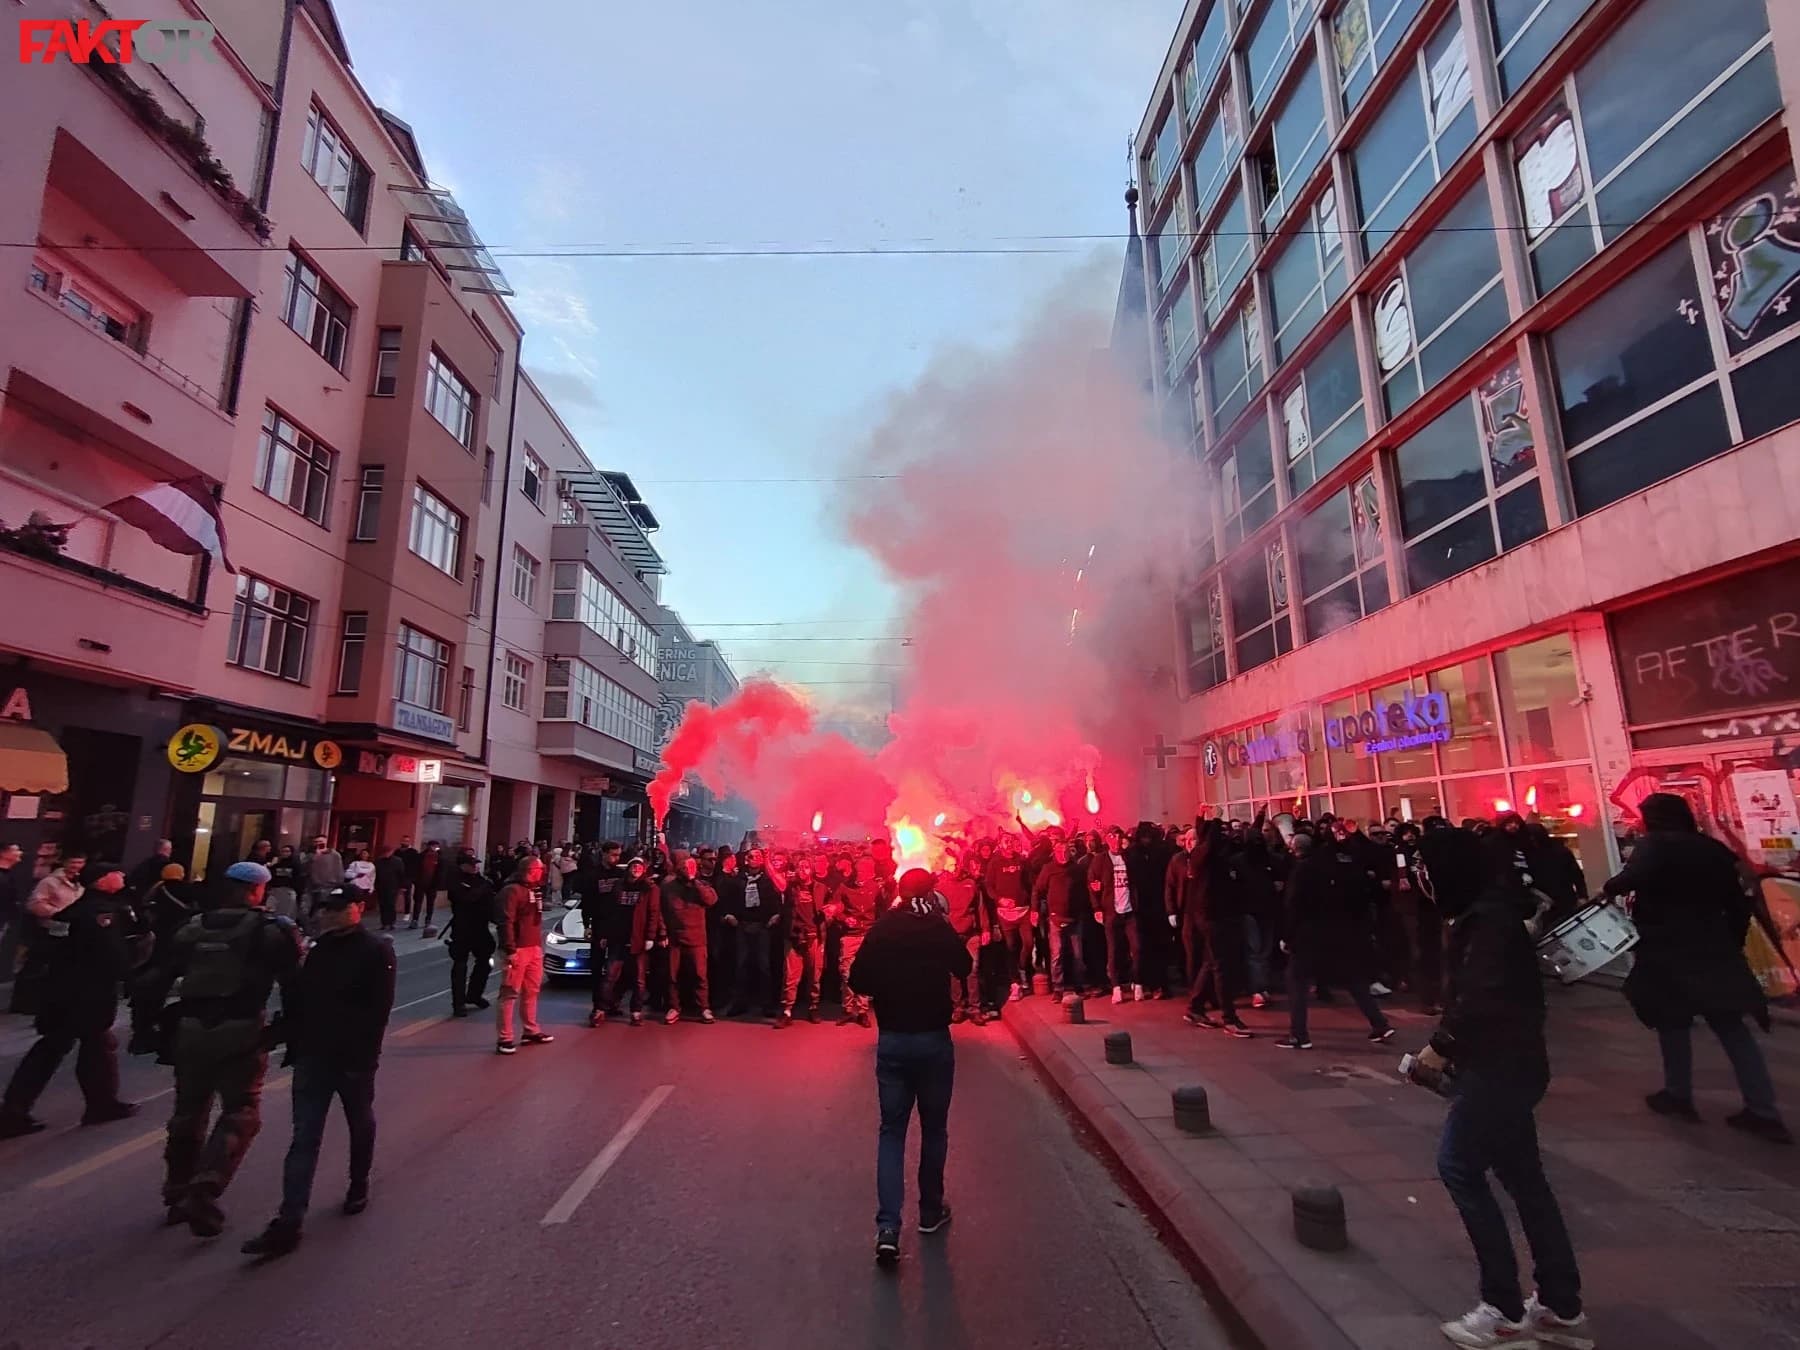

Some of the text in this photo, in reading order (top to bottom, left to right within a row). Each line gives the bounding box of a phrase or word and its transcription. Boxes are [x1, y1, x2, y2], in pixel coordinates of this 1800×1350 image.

[1635, 613, 1800, 684] AFTER
[228, 728, 307, 759] ZMAJ
[1326, 689, 1450, 753] apoteka
